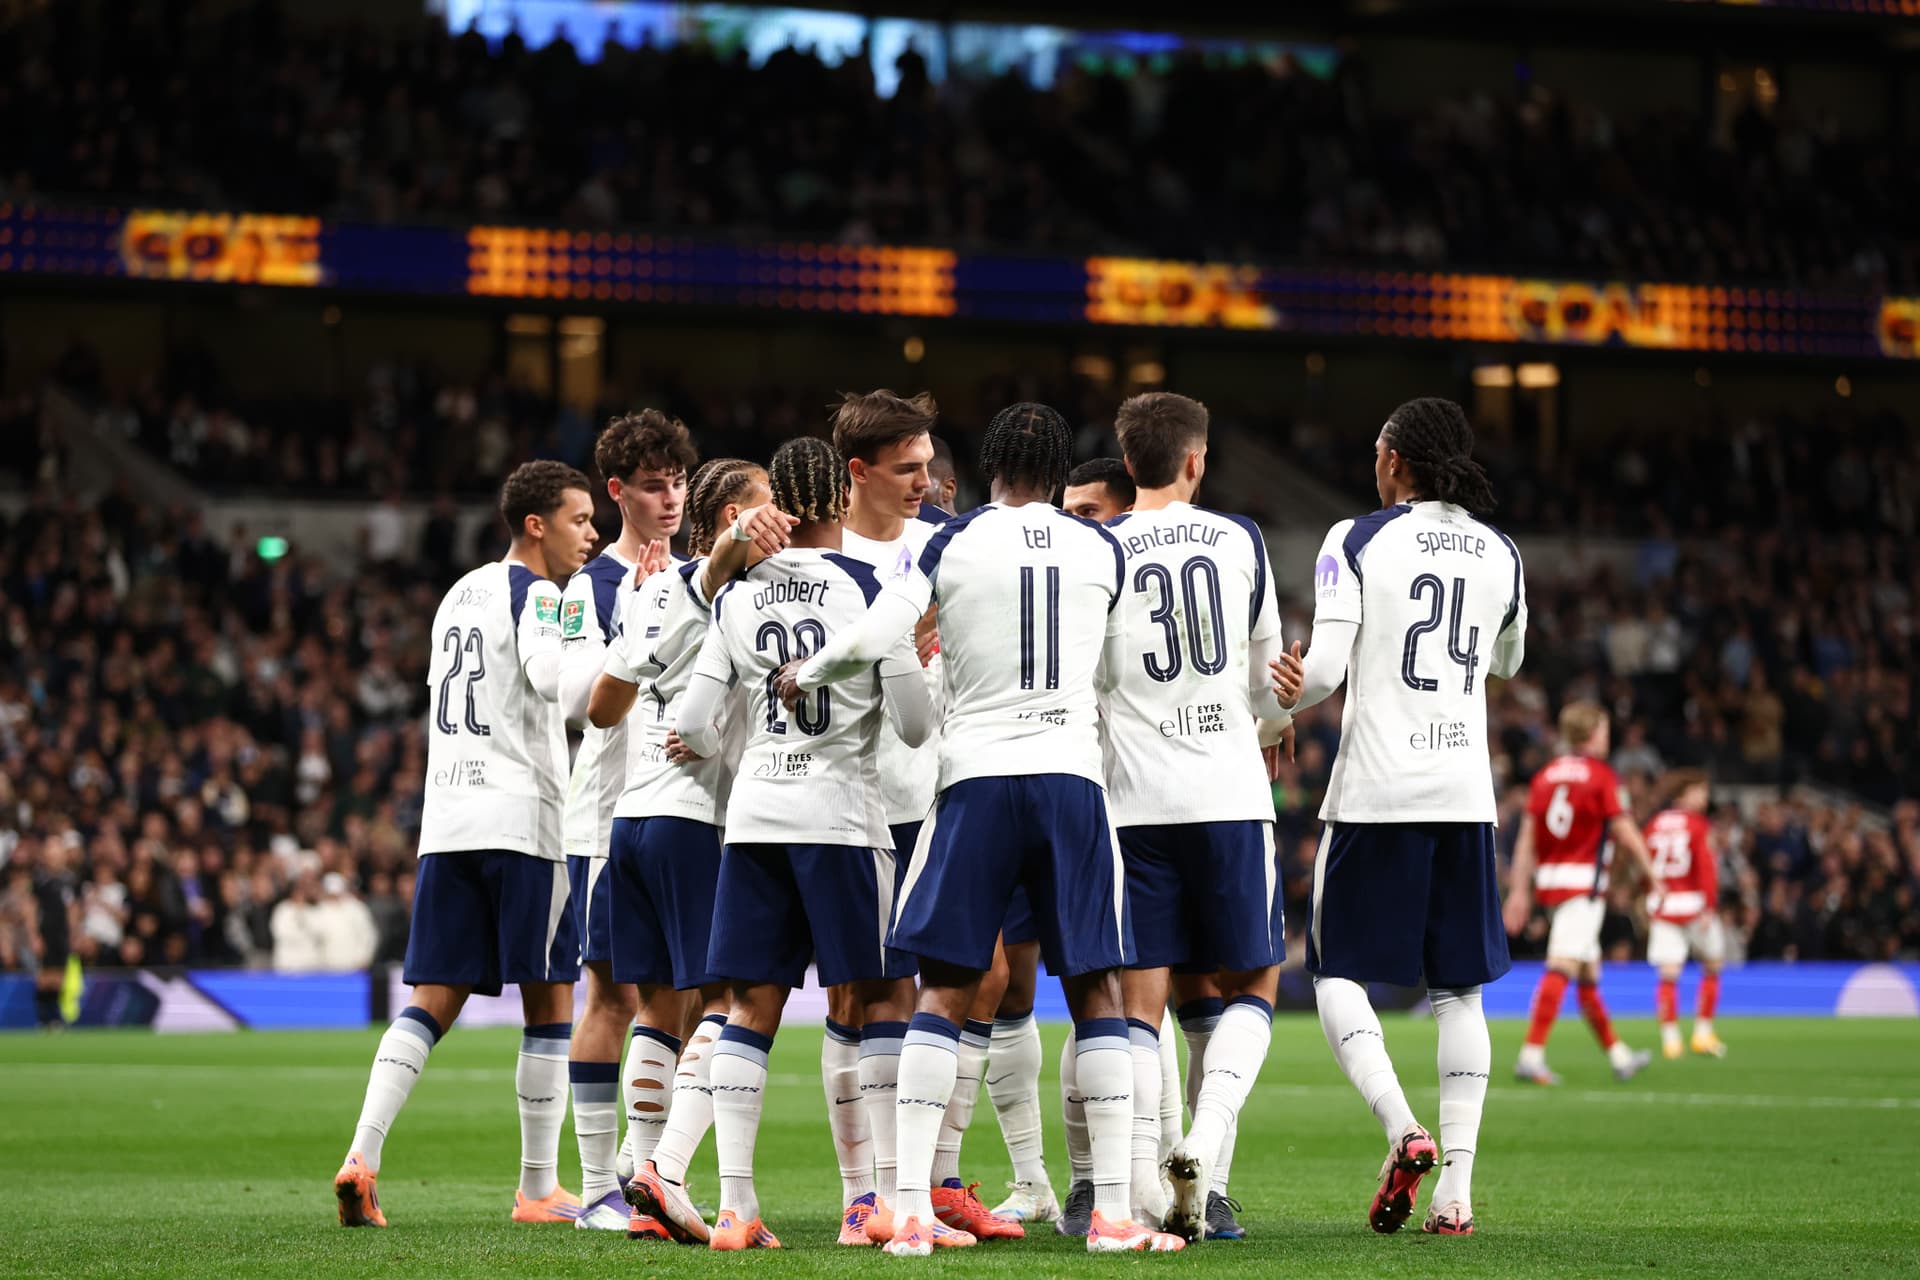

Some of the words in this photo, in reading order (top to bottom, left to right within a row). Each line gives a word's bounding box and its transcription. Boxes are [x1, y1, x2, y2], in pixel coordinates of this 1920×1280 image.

[1023, 525, 1050, 549] tel
[1416, 532, 1486, 559] spence
[753, 576, 829, 610] odobert
[1020, 566, 1059, 690] 11
[1134, 555, 1228, 683] 30
[1401, 573, 1479, 695] 24
[437, 626, 491, 736] 22
[1160, 705, 1194, 737] elf
[1410, 722, 1449, 751] elf
[435, 760, 464, 787] elf
[1546, 784, 1574, 840] 6
